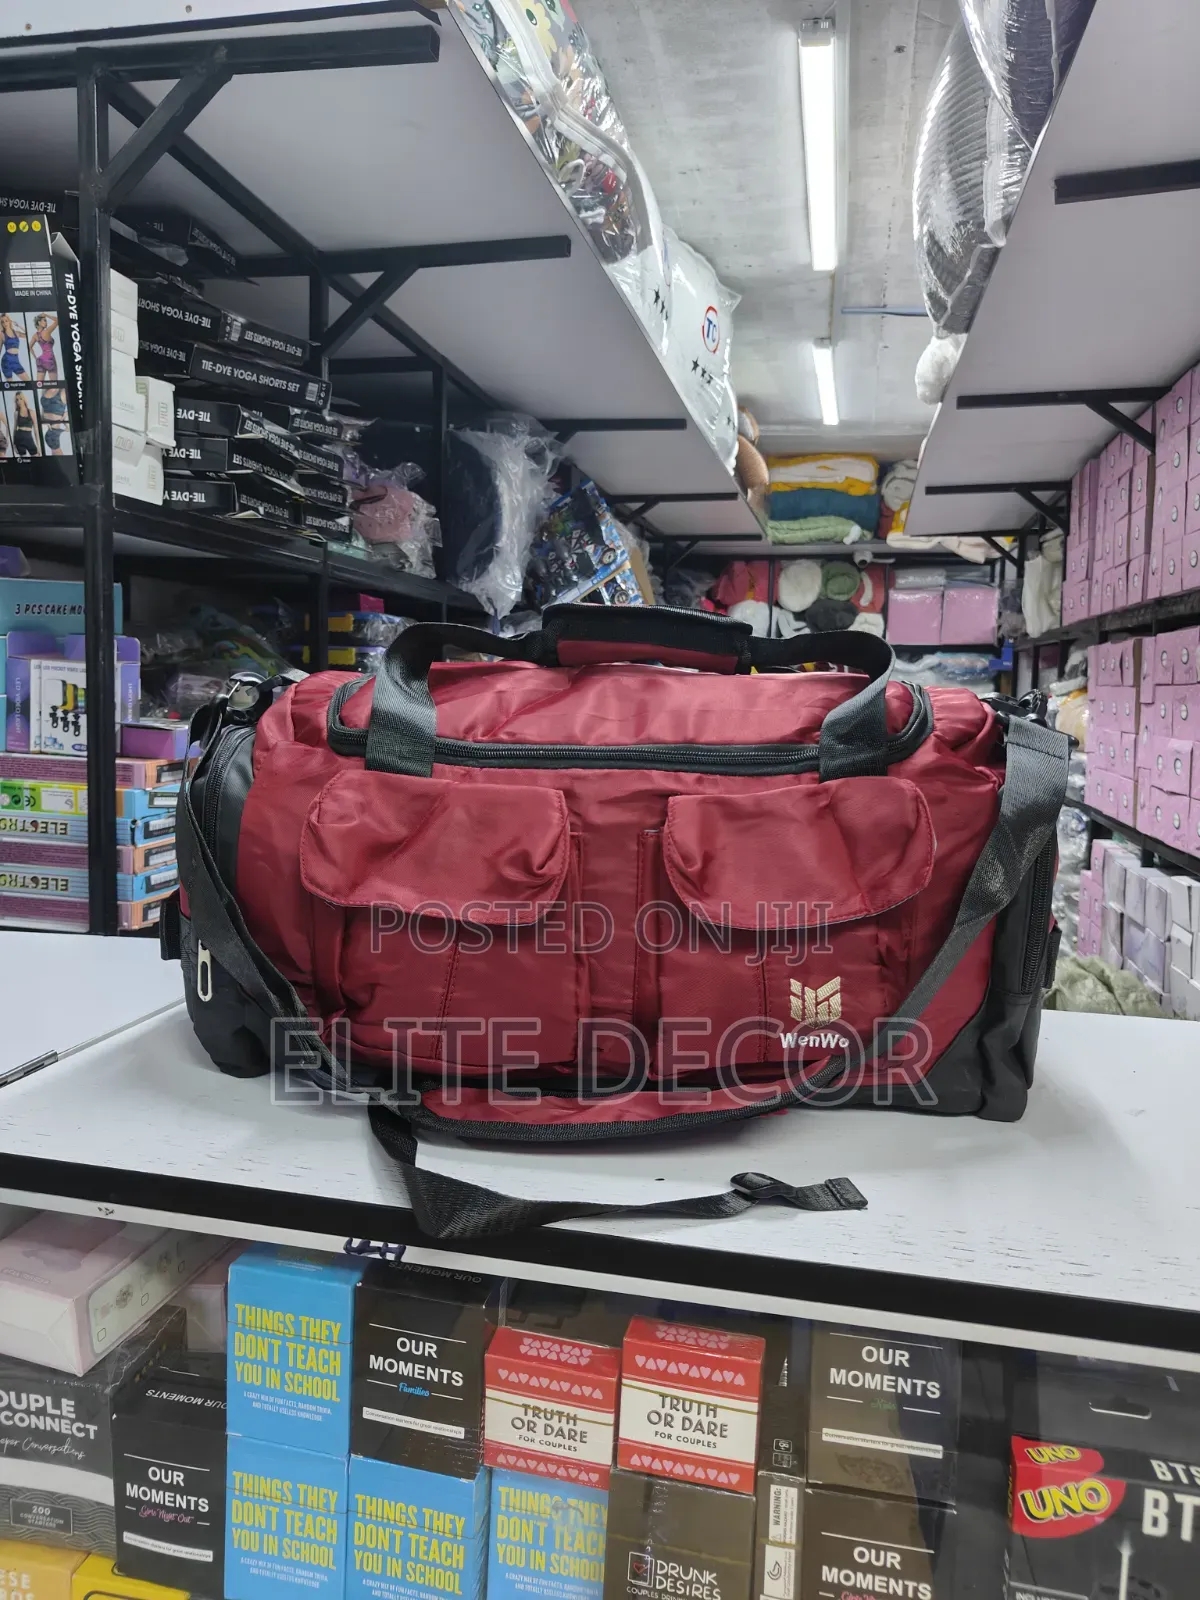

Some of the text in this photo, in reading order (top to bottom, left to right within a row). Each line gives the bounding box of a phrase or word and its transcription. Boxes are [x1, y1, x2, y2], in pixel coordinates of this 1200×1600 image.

[9, 198, 30, 209] YOGA
[64, 273, 78, 319] TIE-DYE
[161, 305, 184, 320] YOGA
[184, 312, 212, 329] TIE-DYE
[70, 323, 82, 363] YOGA
[706, 316, 718, 343] TC
[201, 359, 301, 393] TIE-DYE YOGA SHORTS SET
[176, 408, 211, 423] TIE-DYE
[168, 447, 202, 460] TIE-DYE
[171, 490, 206, 503] TIE-DYE
[15, 603, 21, 615] 3
[24, 604, 43, 615] PCS
[44, 604, 67, 616] CAKE
[779, 1032, 850, 1049] WenWo
[389, 1261, 482, 1284] OUR MOMENTS
[235, 1303, 342, 1346] THINGS THEY
[234, 1331, 341, 1377] DON'T TEACH
[396, 1337, 438, 1359] OUR
[861, 1345, 910, 1368] OUR
[234, 1360, 341, 1402] YOU IN SCHOOL
[369, 1354, 464, 1387] MOMENTS
[830, 1367, 941, 1399] MOMENTS
[145, 1388, 227, 1410] OUR MOMENTS
[398, 1381, 430, 1397] Families
[521, 1403, 578, 1427] TRUTH
[659, 1394, 718, 1419] TRUTH
[0, 1411, 98, 1440] CONNECT
[510, 1417, 588, 1444] OR DARE
[646, 1409, 729, 1439] OR DARE
[518, 1434, 578, 1452] FOR COUPLES
[654, 1430, 717, 1449] FOR COUPLES
[1025, 1445, 1081, 1465] UNO
[148, 1466, 185, 1487] OUR
[1150, 1459, 1200, 1488] BTS
[126, 1482, 210, 1513] MOMENTS
[232, 1470, 338, 1515] THINGS THEY
[1019, 1477, 1112, 1524] UNO
[32, 1505, 51, 1516] 200
[355, 1494, 466, 1540] THINGS THEY
[772, 1488, 782, 1526] WARNING:
[1142, 1488, 1200, 1543] BT
[231, 1499, 338, 1545] DON'T TEACH
[496, 1514, 548, 1547] DON'T
[231, 1527, 260, 1552] YOU
[263, 1533, 279, 1557] IN
[281, 1537, 337, 1571] SCHOOL
[354, 1521, 465, 1570] DON'T TEACH
[496, 1542, 526, 1568] YOU
[529, 1548, 546, 1573] IN
[853, 1546, 902, 1571] OUR
[354, 1549, 382, 1575] YOU
[386, 1556, 402, 1580] IN
[406, 1561, 463, 1595] SCHOOL
[656, 1560, 718, 1586] DRUNK
[821, 1565, 932, 1600] MOMENTS
[626, 1586, 659, 1599] COUPLES
